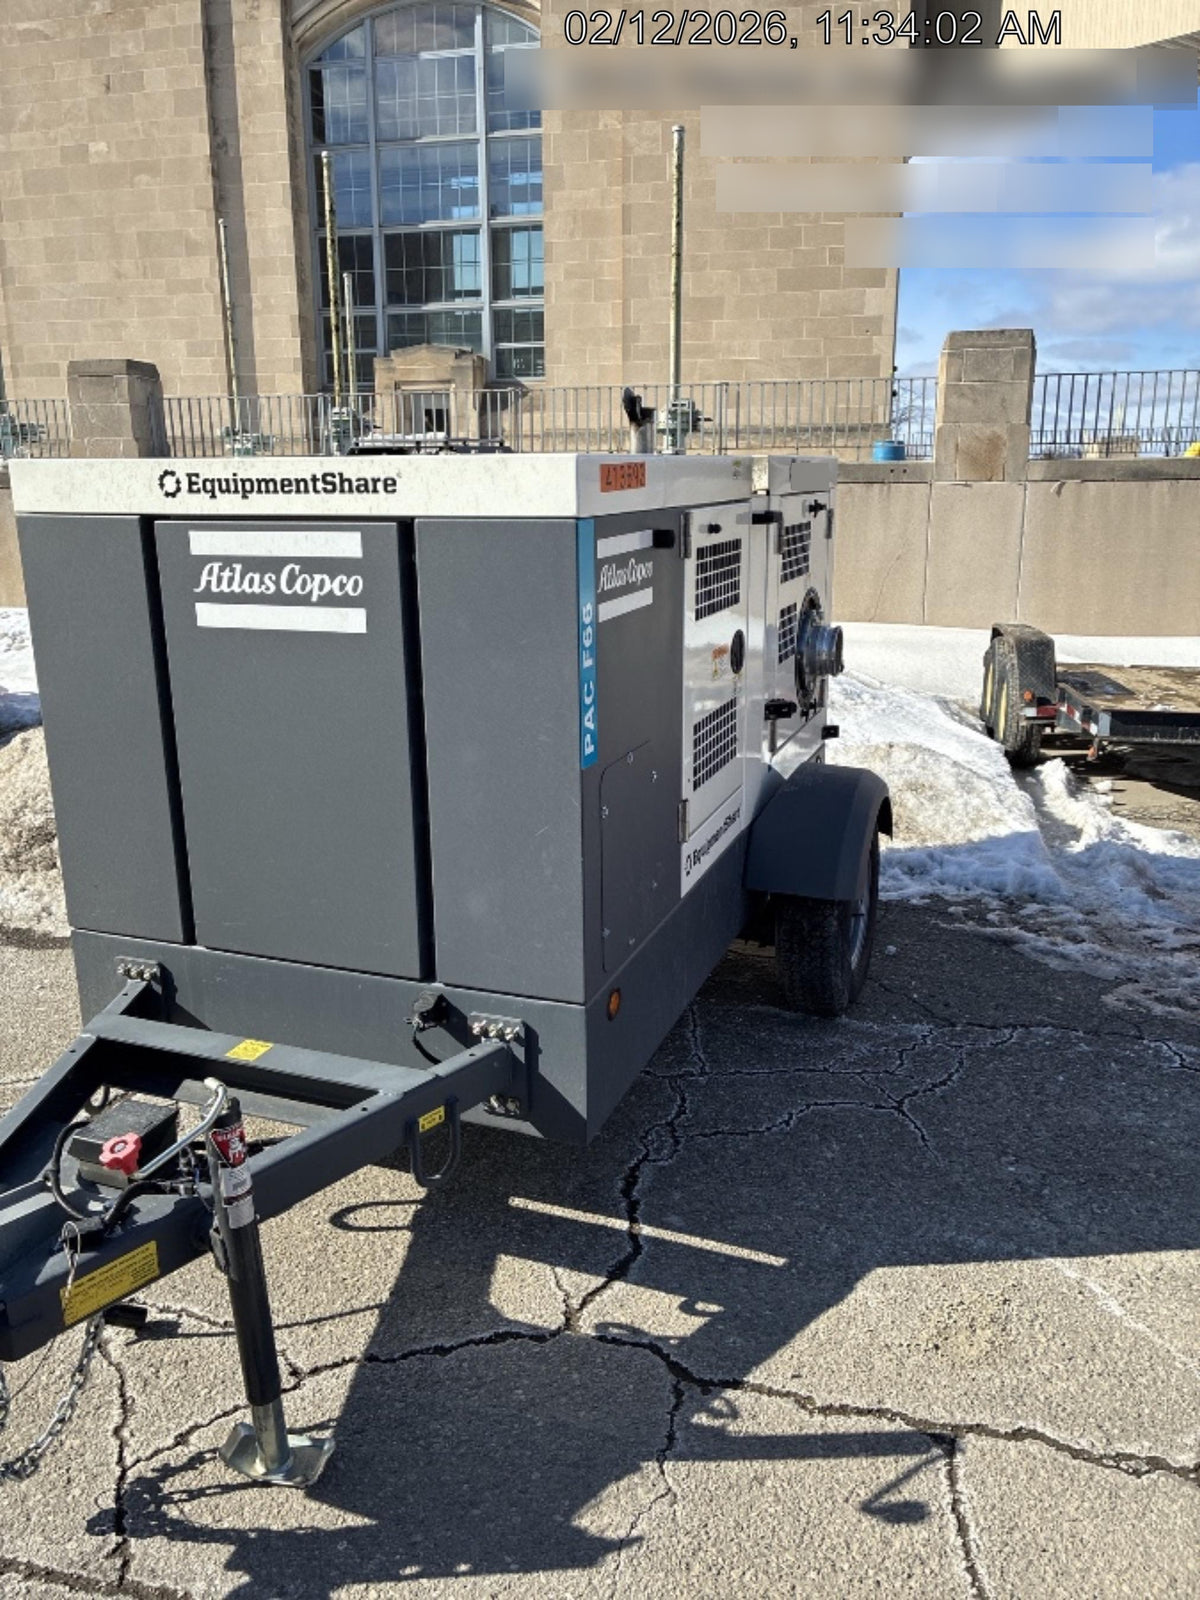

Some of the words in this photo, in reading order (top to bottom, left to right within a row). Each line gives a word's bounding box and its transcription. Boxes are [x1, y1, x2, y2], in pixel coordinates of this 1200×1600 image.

[186, 472, 397, 499] EquipmentShare
[193, 562, 276, 593] Atlas
[280, 563, 363, 602] Copco
[597, 564, 630, 592] Atlas
[582, 602, 594, 668] F66
[583, 681, 595, 755] PAC
